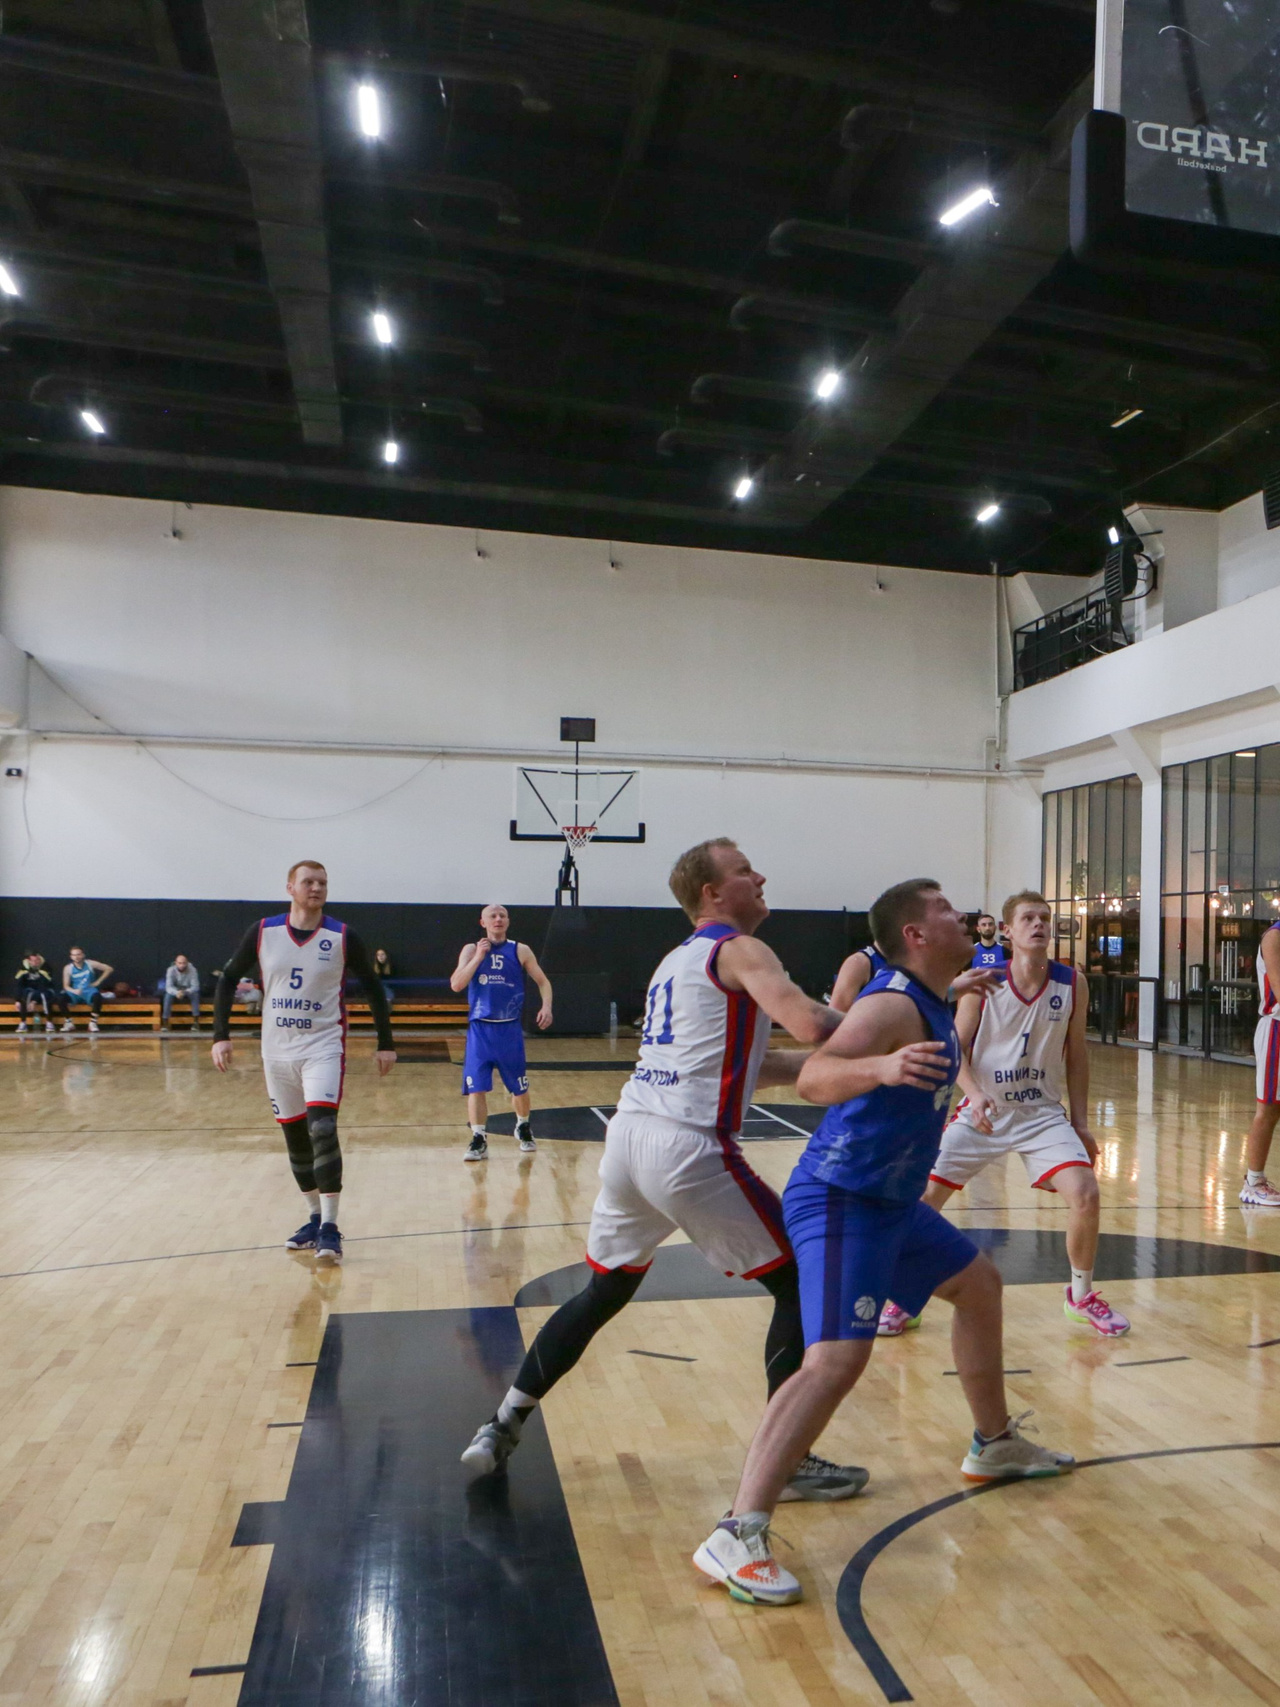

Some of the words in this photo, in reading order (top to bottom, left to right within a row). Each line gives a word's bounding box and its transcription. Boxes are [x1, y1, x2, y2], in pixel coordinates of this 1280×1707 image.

[490, 953, 505, 970] 15
[981, 953, 996, 964] 33
[289, 967, 303, 990] 5
[272, 998, 322, 1012] ВНИИЭФ
[642, 975, 675, 1046] 11
[276, 1016, 312, 1029] САРОВ
[1020, 1032, 1030, 1058] 1
[517, 1075, 530, 1092] 15
[1004, 1087, 1043, 1103] САРОВ
